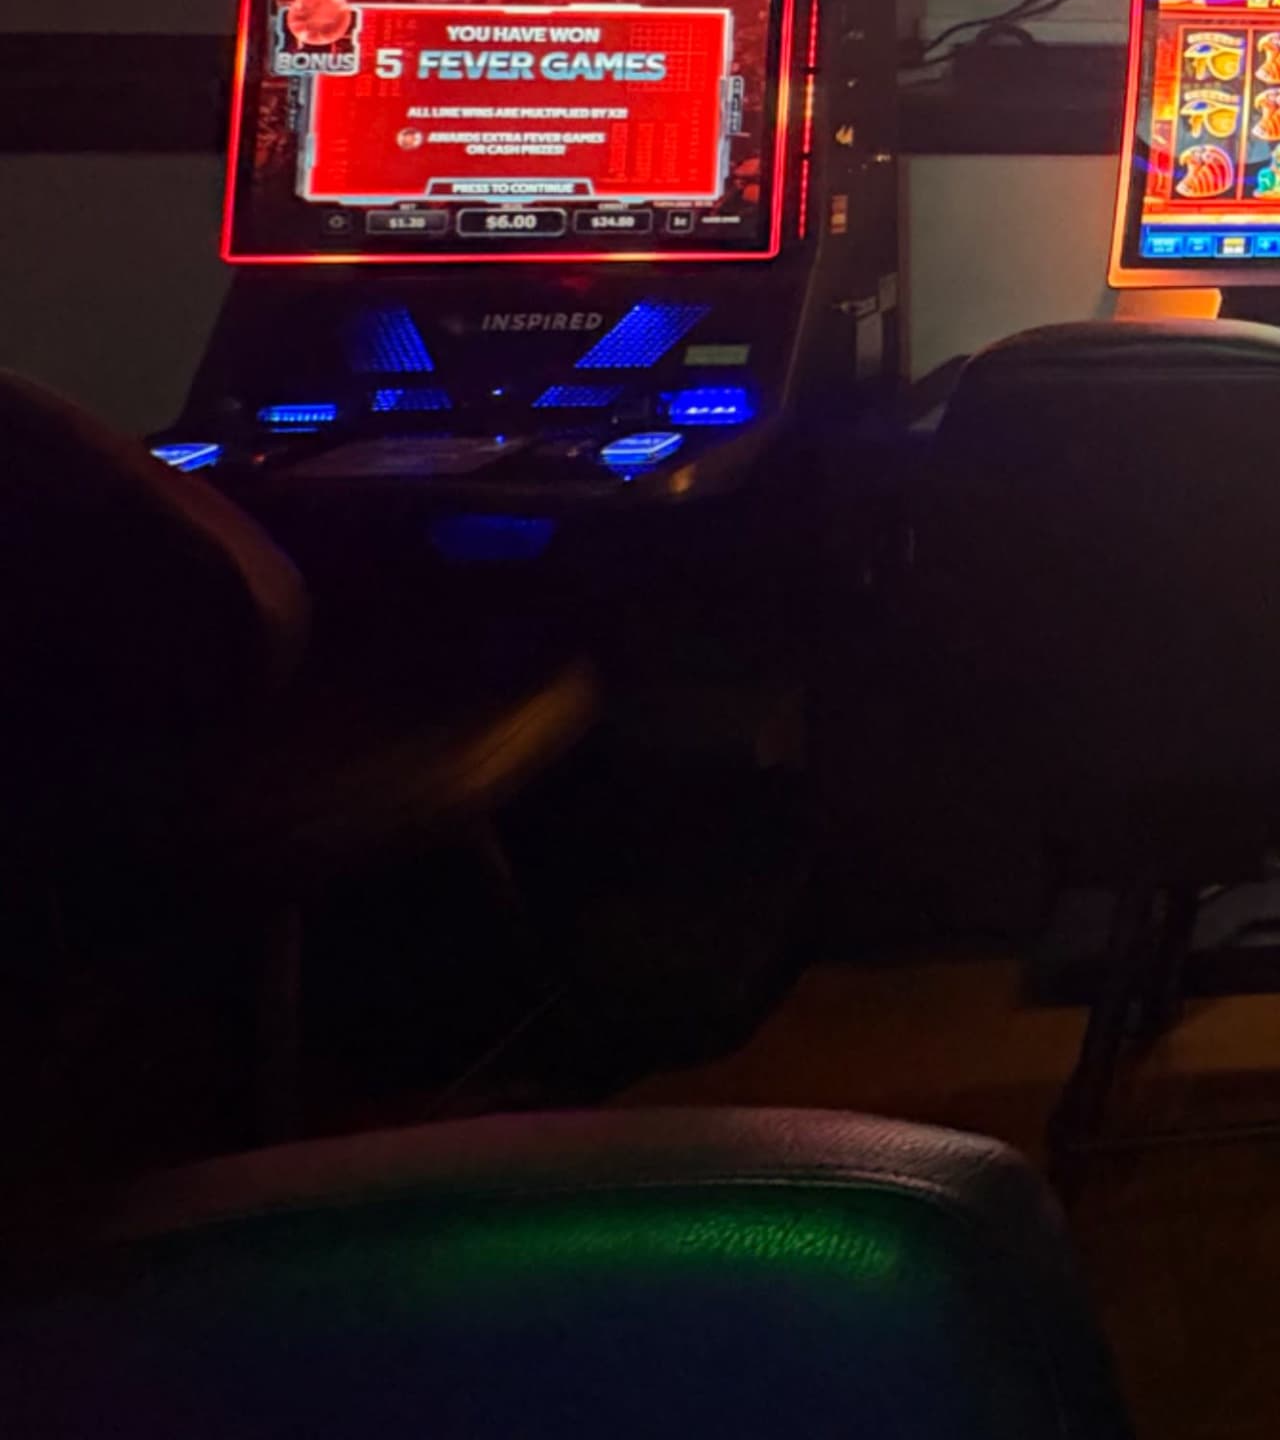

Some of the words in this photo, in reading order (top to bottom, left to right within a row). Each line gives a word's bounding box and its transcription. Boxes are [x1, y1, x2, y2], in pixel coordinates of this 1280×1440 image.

[447, 26, 491, 42] YOU
[494, 27, 546, 42] HAVE
[548, 27, 600, 43] WON
[276, 53, 356, 71] BONUS
[376, 48, 403, 79] 5
[418, 50, 535, 80] FEVER
[540, 52, 667, 81] GAMES
[486, 215, 538, 230] $6.00
[482, 313, 602, 331] INSPIRED
